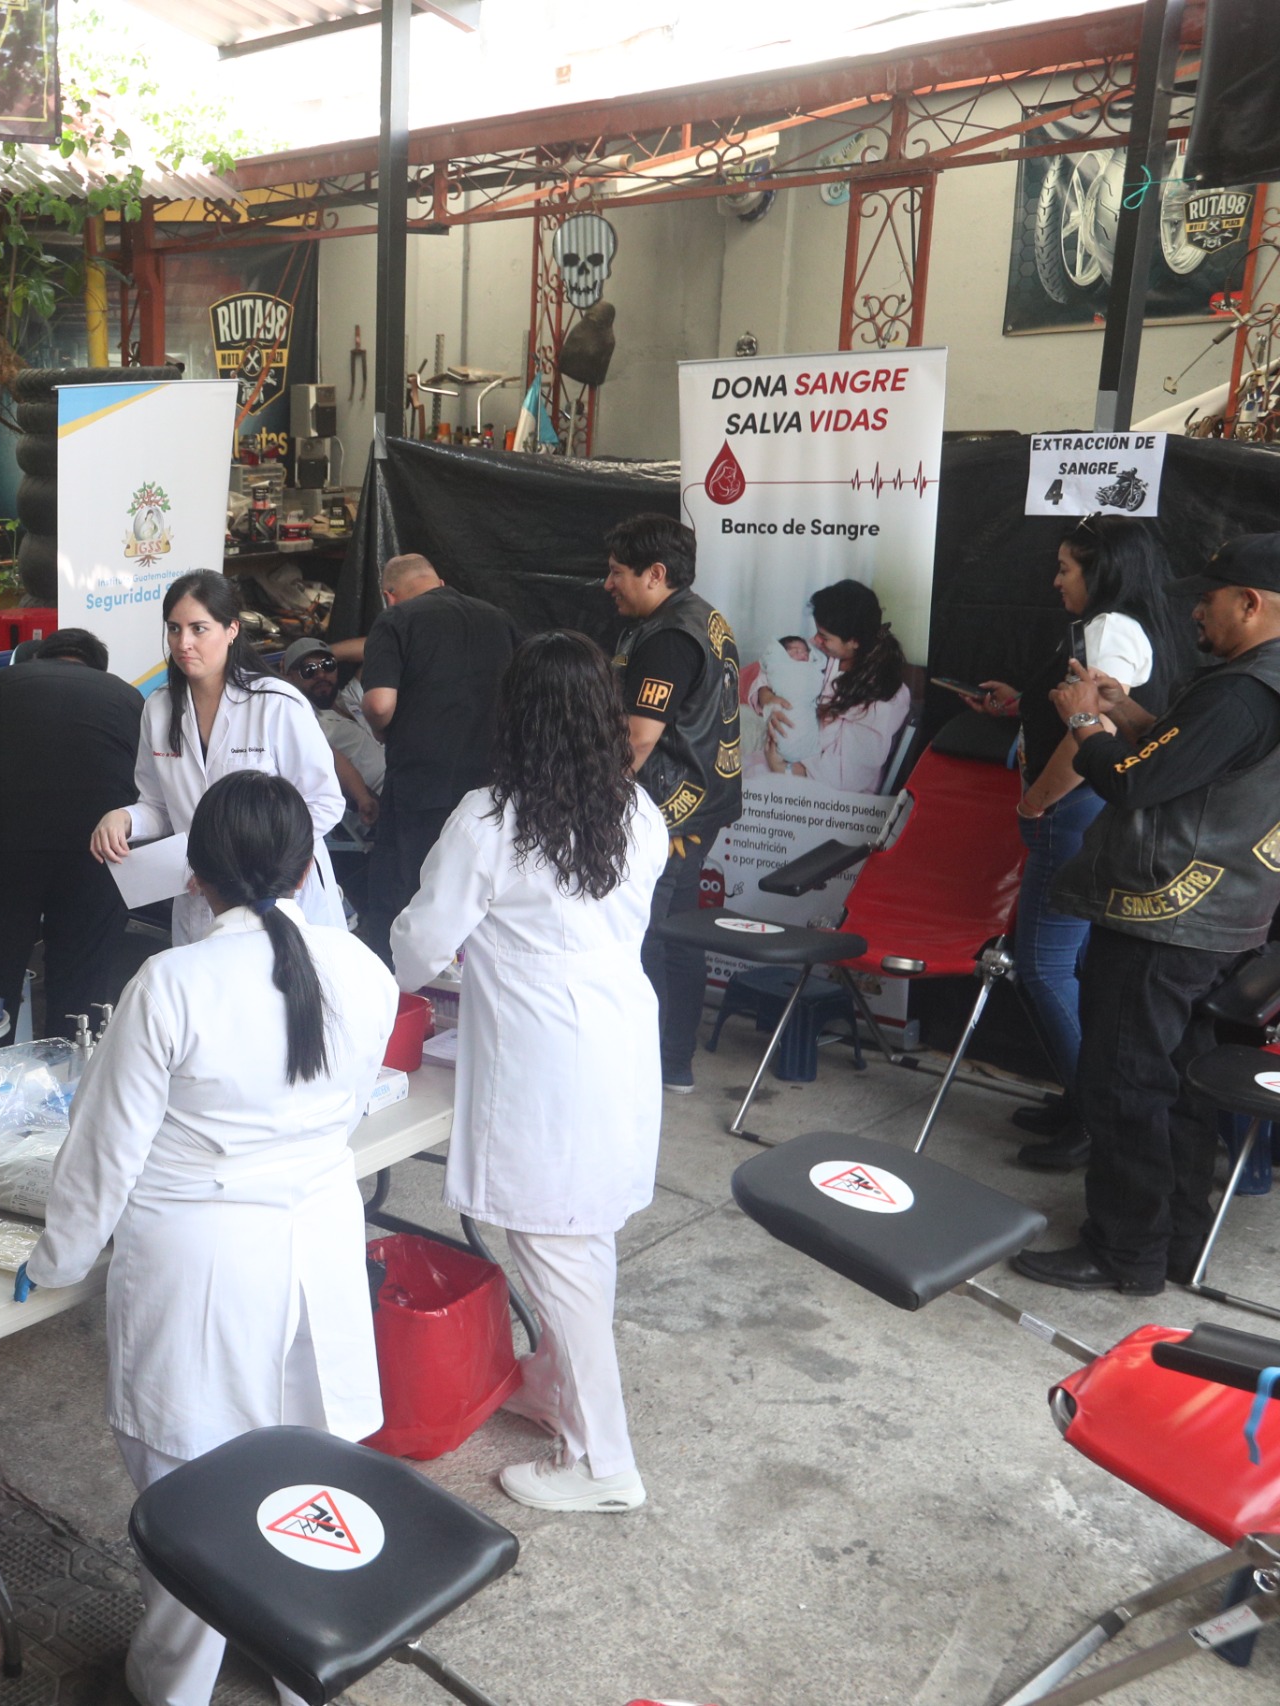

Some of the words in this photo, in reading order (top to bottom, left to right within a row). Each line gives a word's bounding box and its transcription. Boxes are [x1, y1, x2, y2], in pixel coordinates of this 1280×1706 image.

[1189, 194, 1247, 220] RUTA98
[217, 299, 288, 343] RUTA98
[221, 352, 240, 366] MOTO
[711, 374, 788, 400] DONA
[794, 367, 909, 396] SANGRE
[725, 411, 802, 435] SALVA
[809, 408, 889, 433] VIDAS
[1032, 434, 1129, 451] EXTRACCIÓN
[1135, 436, 1156, 450] DE
[1058, 462, 1119, 475] SANGRE
[1044, 479, 1063, 505] 4
[721, 518, 778, 535] Banco
[782, 518, 806, 535] de
[810, 519, 880, 541] Sangre
[135, 540, 162, 554] IGSS
[133, 570, 184, 583] Guatemalteco
[86, 584, 161, 612] Seguridad
[641, 682, 669, 706] HP
[668, 789, 697, 821] 2018
[743, 789, 762, 801] dres
[764, 794, 769, 805] y
[770, 792, 783, 804] los
[785, 795, 811, 808] recién
[814, 800, 850, 813] nacidos
[852, 805, 887, 818] pueden
[733, 822, 767, 835] anemia
[768, 827, 796, 840] grave,
[748, 806, 807, 824] transfusiones
[808, 816, 824, 828] por
[825, 816, 864, 832] diversas
[733, 837, 787, 854] malnutrición
[732, 855, 738, 863] o
[740, 856, 755, 867] por
[1121, 893, 1174, 916] SINCE
[1169, 870, 1212, 906] 2018
